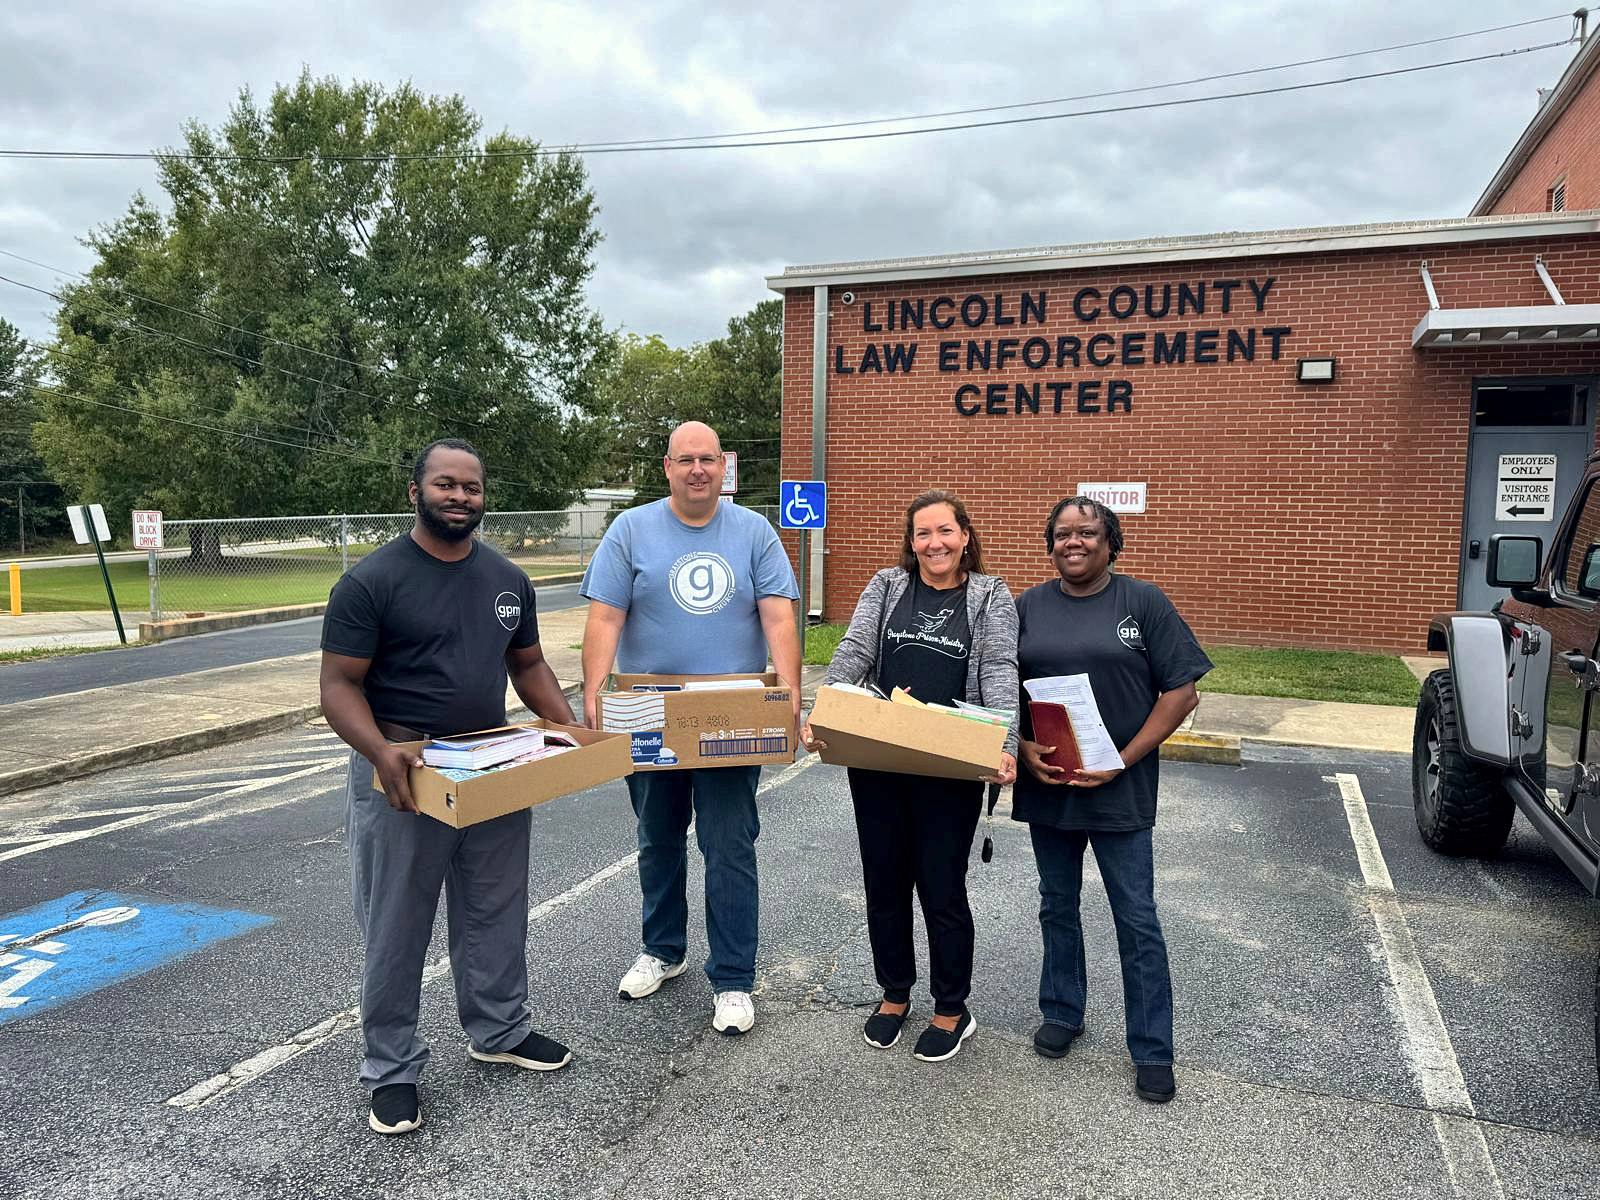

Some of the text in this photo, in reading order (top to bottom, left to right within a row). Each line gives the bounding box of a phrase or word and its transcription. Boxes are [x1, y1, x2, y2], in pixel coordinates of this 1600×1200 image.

[863, 277, 1276, 332] LINCOLN COUNTY
[835, 326, 1292, 373] LAW ENFORCEMENT
[955, 380, 1133, 417] CENTER
[1502, 456, 1555, 465] EMPLOYEES
[1511, 466, 1543, 475] ONLY
[1505, 485, 1549, 493] VISITORS
[1083, 490, 1139, 505] VISITOR
[1501, 494, 1550, 503] ENTRANCE
[136, 514, 158, 523] DO NOT
[139, 525, 157, 535] BLOCK
[140, 536, 158, 546] DRIVE
[669, 551, 697, 579] GRAYSTONE
[689, 564, 714, 601] g
[712, 587, 736, 613] CHURCH
[1120, 627, 1139, 639] gp
[631, 736, 662, 747] ottonelle
